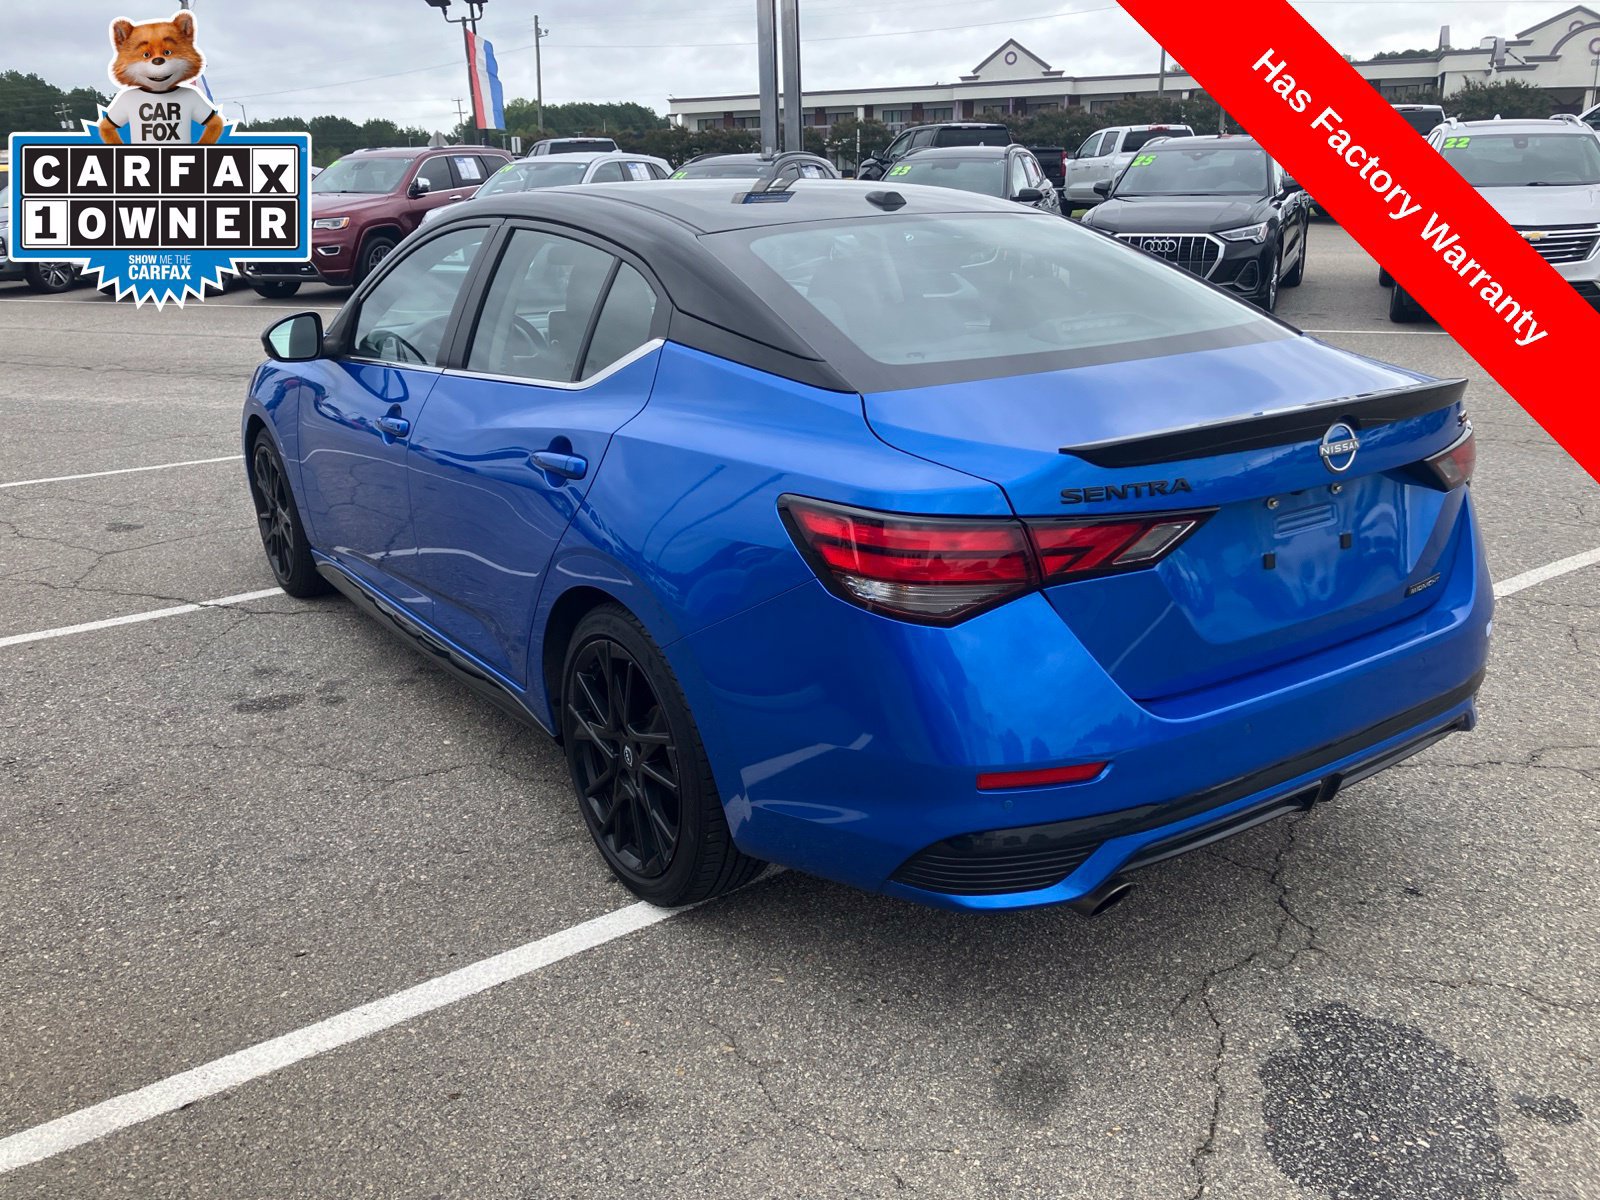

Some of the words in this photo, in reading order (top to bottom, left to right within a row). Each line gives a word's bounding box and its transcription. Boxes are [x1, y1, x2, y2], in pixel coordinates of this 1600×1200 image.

[1443, 136, 1471, 149] 22
[1131, 154, 1157, 167] 25
[1320, 440, 1360, 456] NISSAN
[1060, 477, 1193, 505] SENTRA
